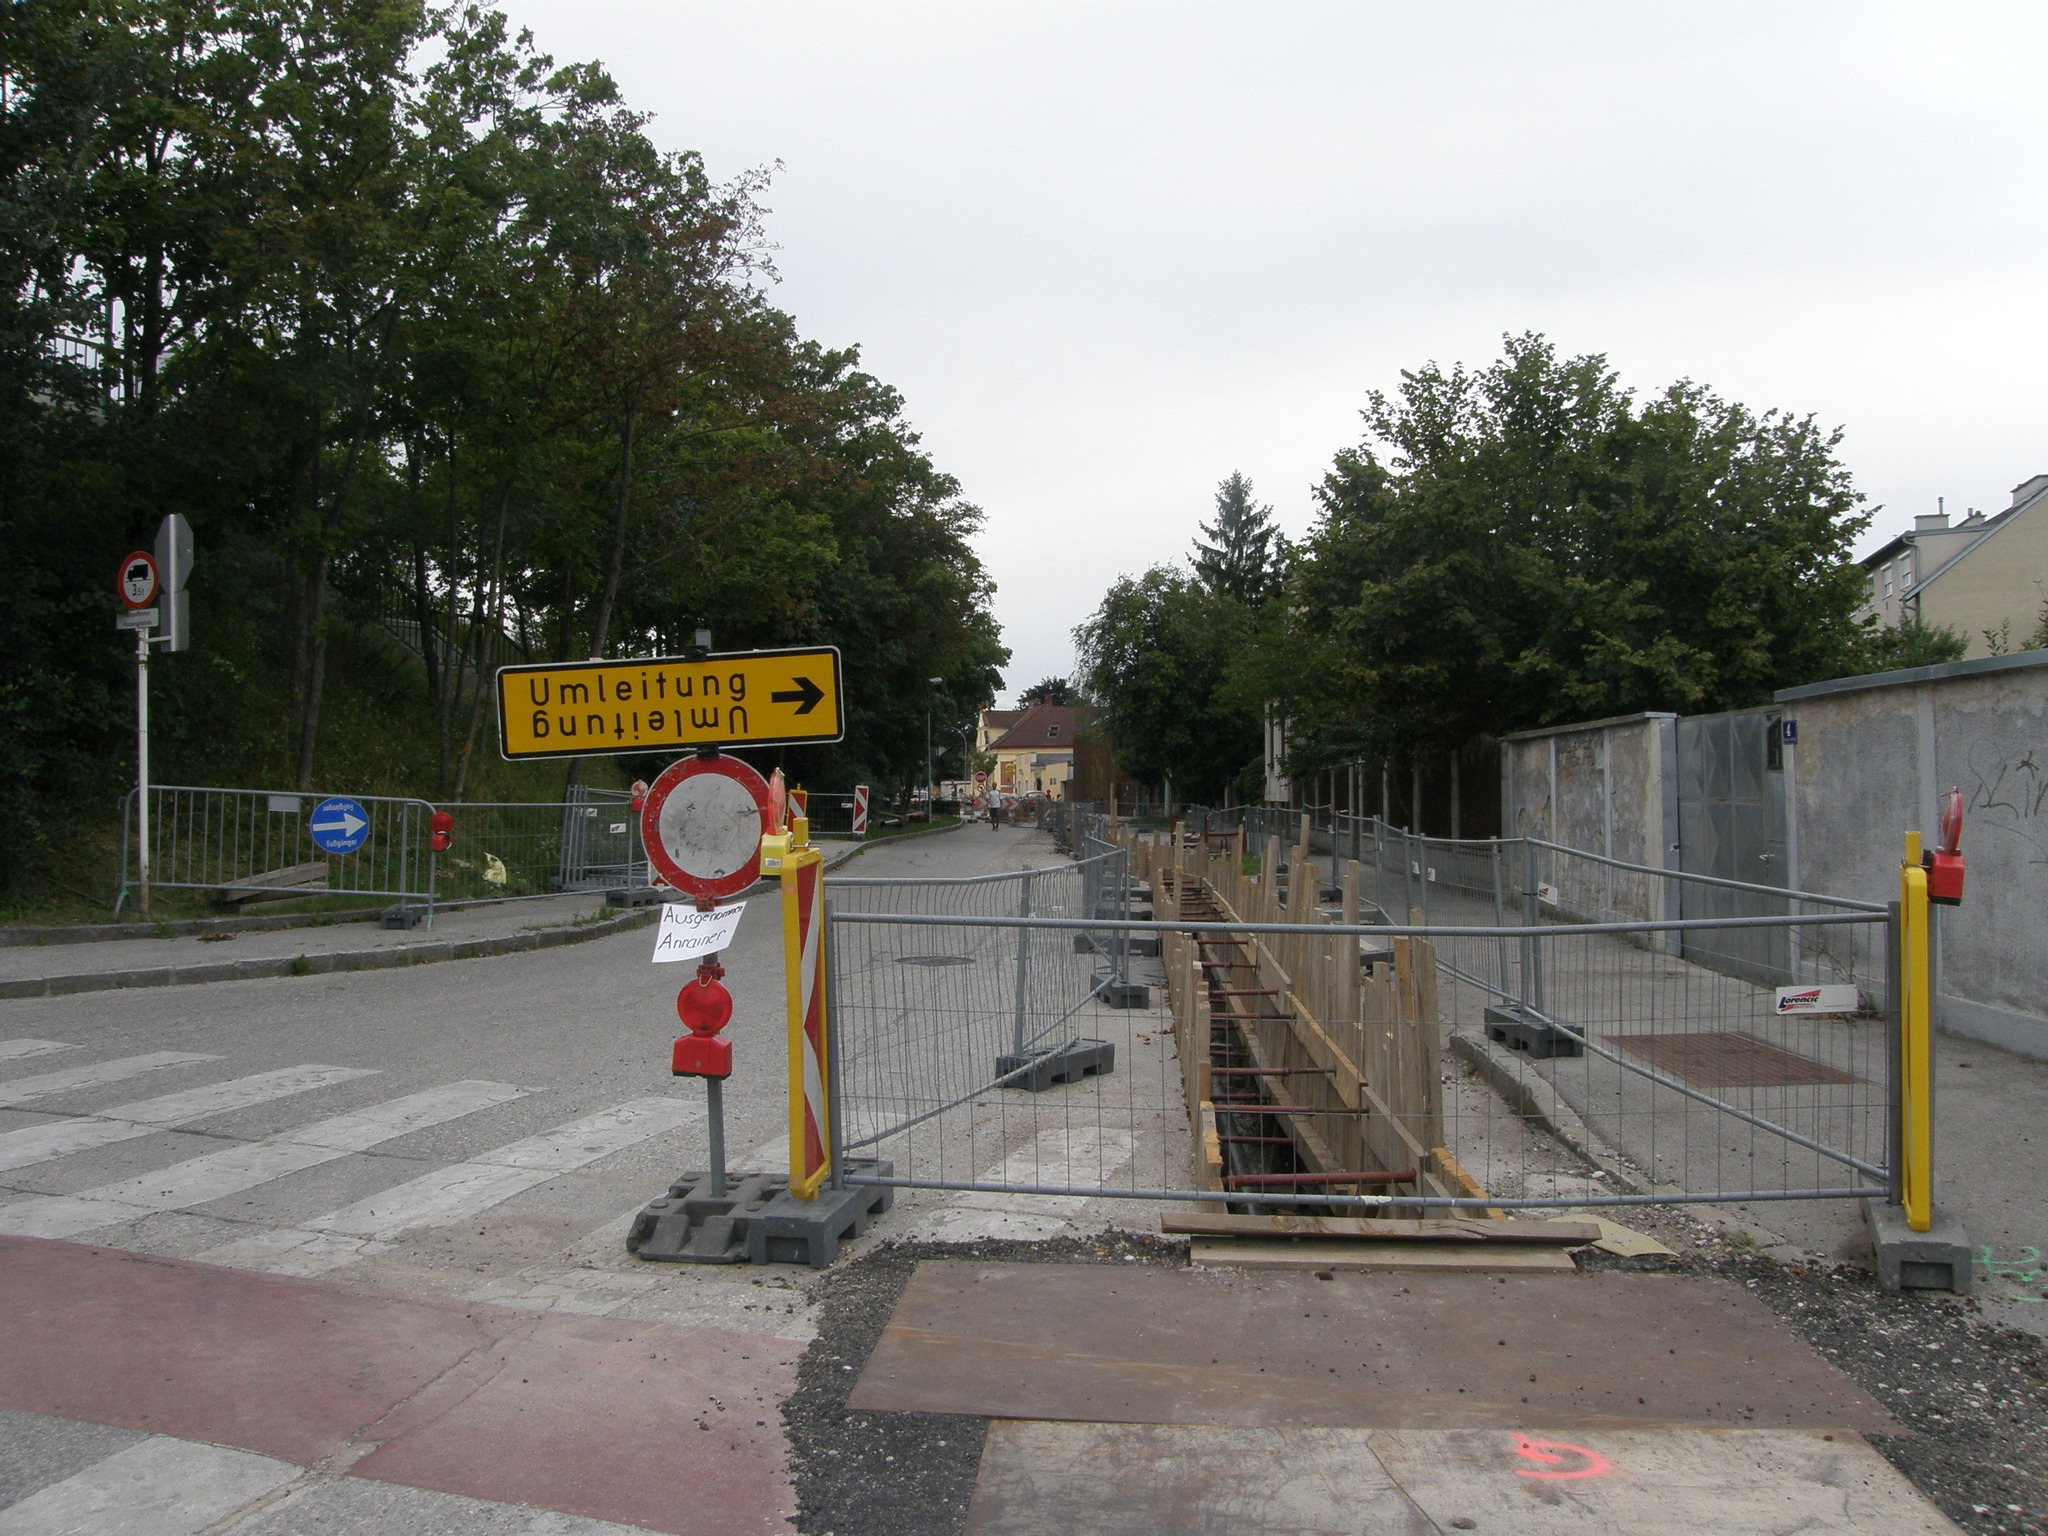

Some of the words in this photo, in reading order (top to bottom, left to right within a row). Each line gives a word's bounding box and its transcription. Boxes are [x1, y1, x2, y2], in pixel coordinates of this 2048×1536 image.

[530, 671, 746, 706] Umleitung
[532, 705, 748, 740] Umleitung
[657, 929, 726, 950] Anrainer
